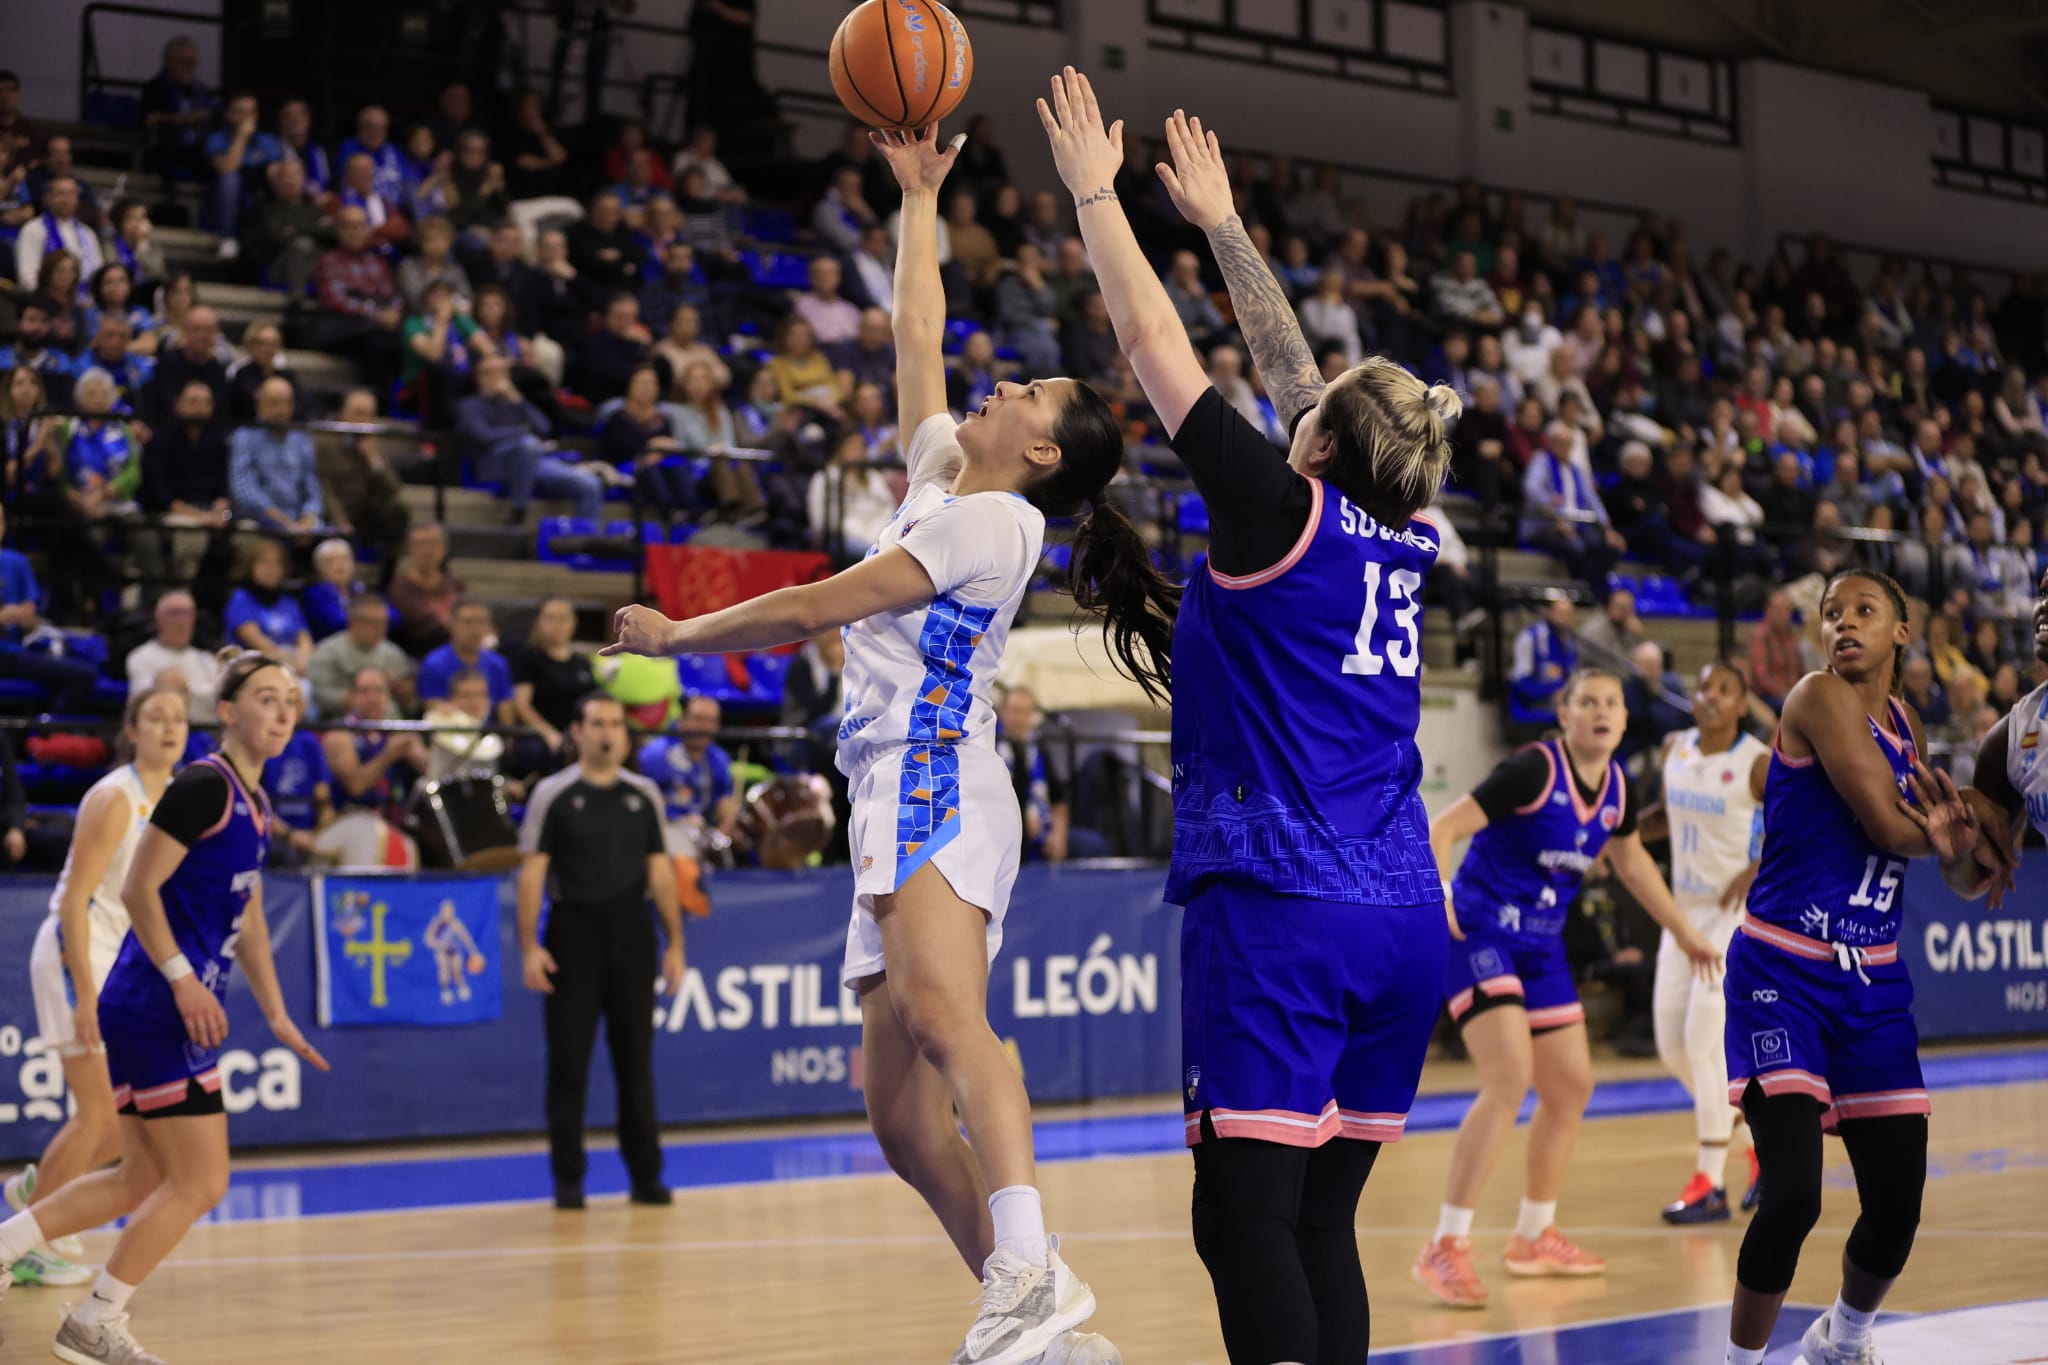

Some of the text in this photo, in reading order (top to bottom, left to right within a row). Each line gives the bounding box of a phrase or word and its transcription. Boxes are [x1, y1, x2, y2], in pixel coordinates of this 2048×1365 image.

[1341, 561, 1421, 677] 13
[1848, 854, 1904, 913] 15
[1014, 934, 1158, 1018] LEÓN
[772, 1046, 846, 1085] NOS
